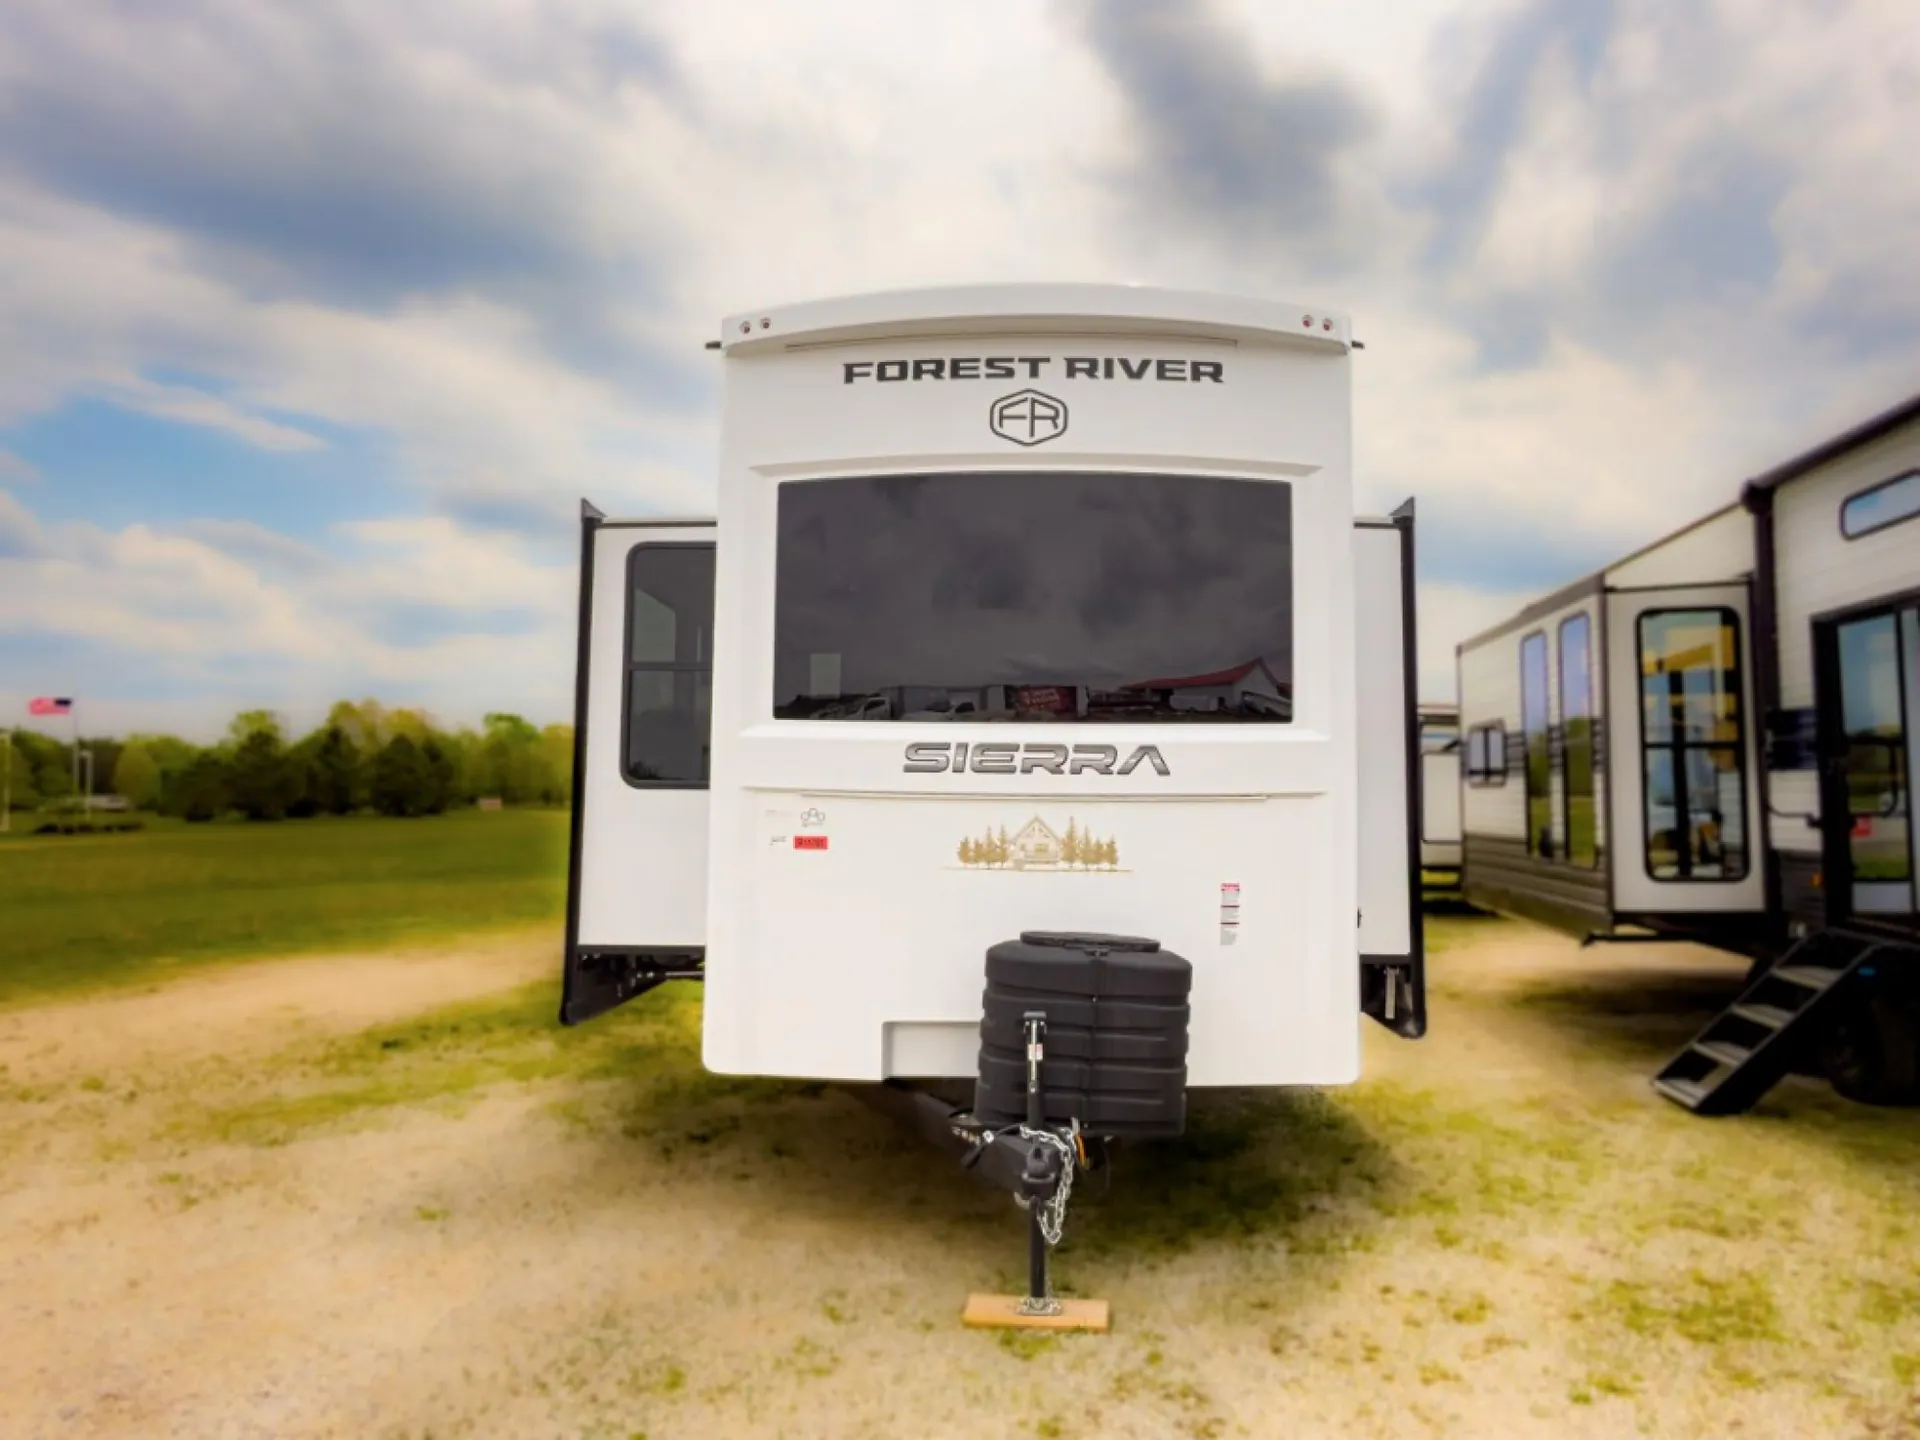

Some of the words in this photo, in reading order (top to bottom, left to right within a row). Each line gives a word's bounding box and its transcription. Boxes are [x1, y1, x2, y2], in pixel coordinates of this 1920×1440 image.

[843, 357, 1050, 384] FOREST
[1063, 357, 1224, 383] RIVER
[998, 396, 1060, 438] FR
[903, 742, 1171, 776] SIERRA
